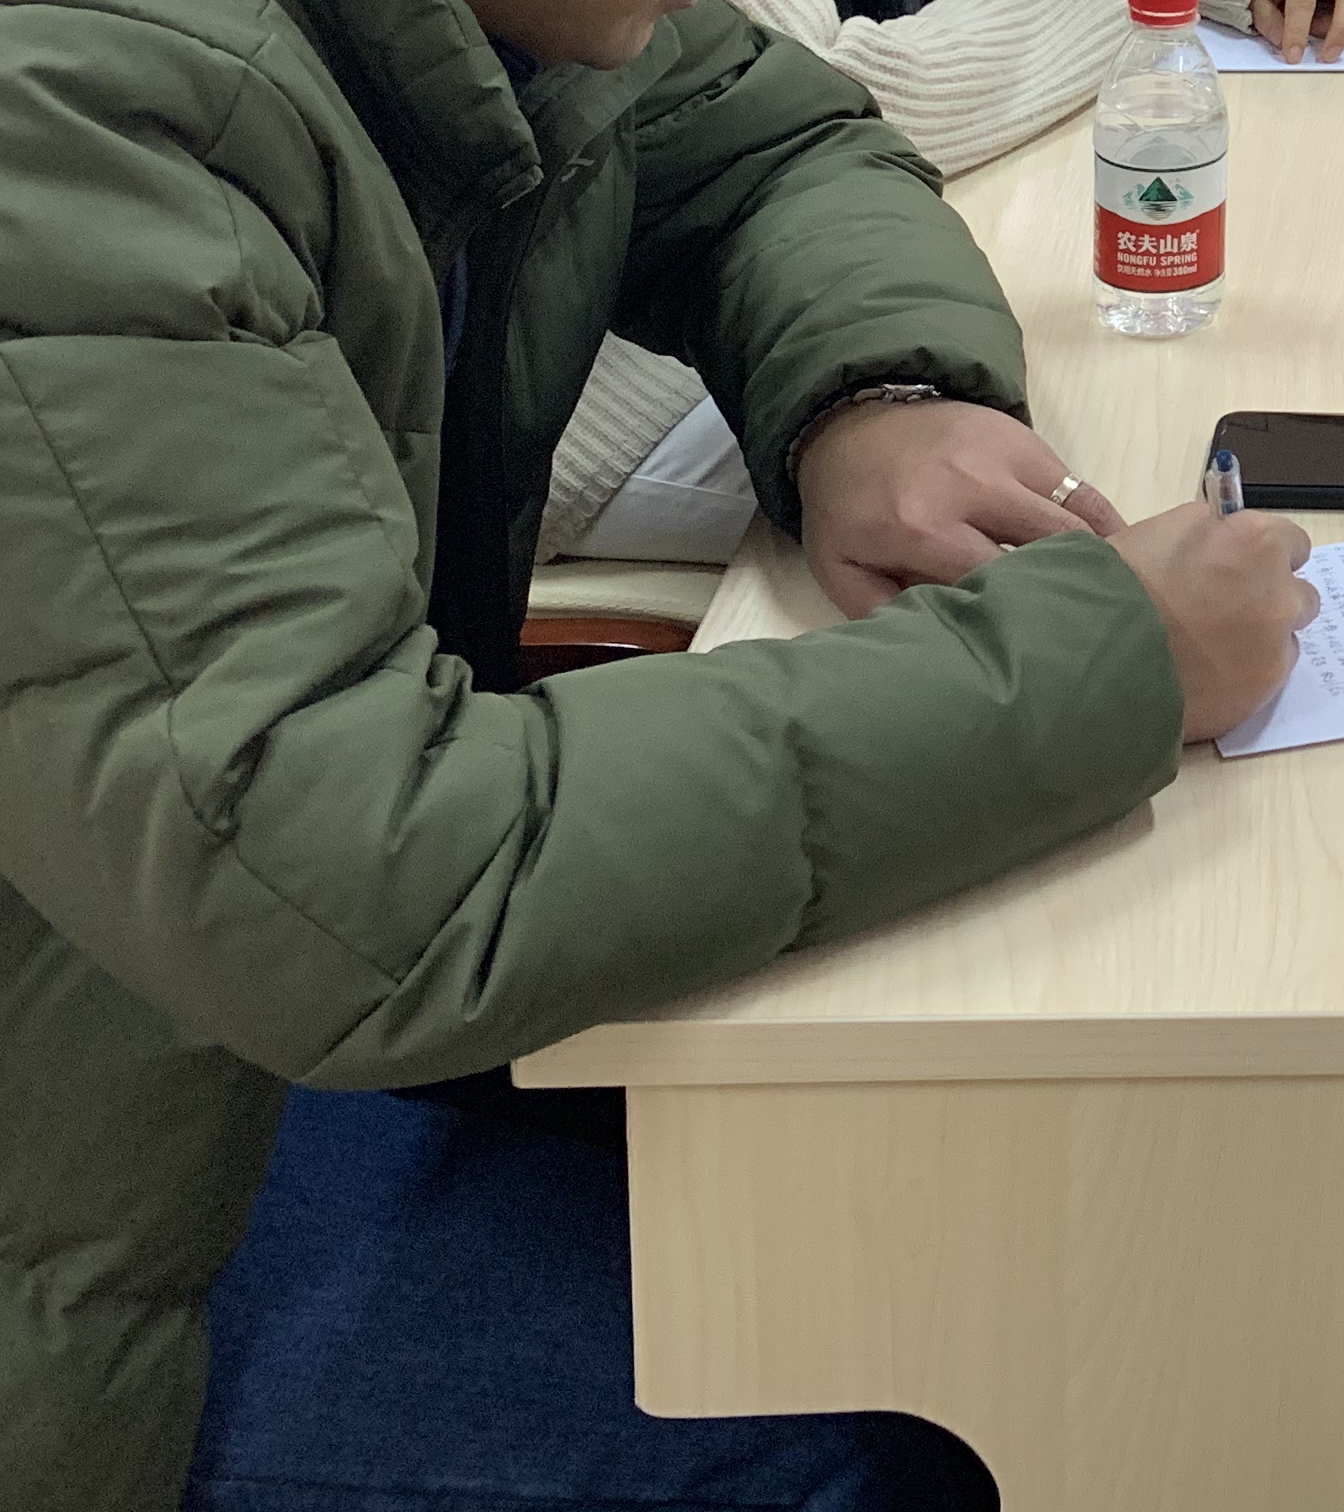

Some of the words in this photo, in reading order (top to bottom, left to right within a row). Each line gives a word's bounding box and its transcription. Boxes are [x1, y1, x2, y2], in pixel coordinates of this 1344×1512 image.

[1117, 231, 1198, 254] 农夫山泉
[1117, 252, 1157, 266] NONGFU
[1160, 252, 1198, 266] SPRING
